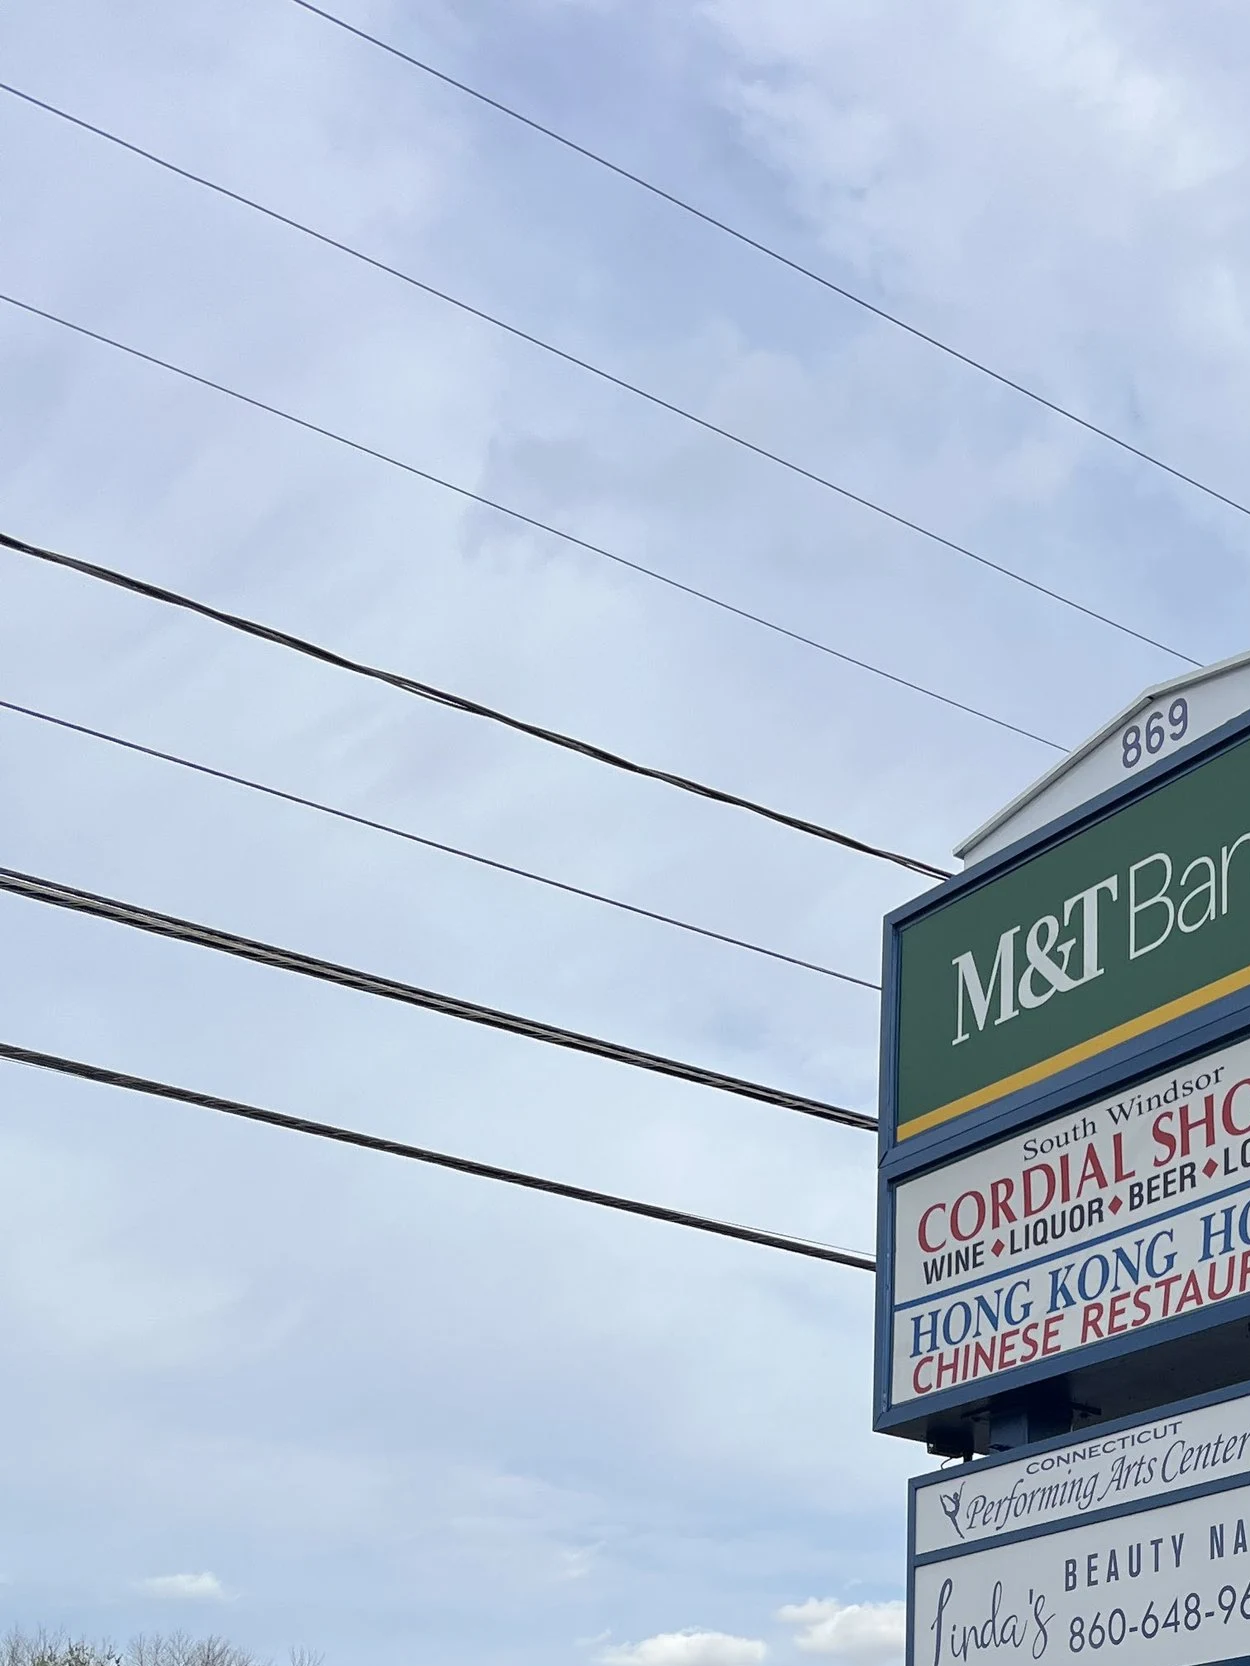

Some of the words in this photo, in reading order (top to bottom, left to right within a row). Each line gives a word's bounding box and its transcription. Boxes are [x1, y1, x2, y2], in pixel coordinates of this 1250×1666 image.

[1120, 698, 1189, 770] 869
[950, 874, 1118, 1047] M&T
[1023, 1119, 1097, 1161] South
[1108, 1065, 1226, 1122] Windsor
[917, 1132, 1136, 1254] CORDIAL
[923, 1239, 985, 1285] WINE
[1009, 1196, 1104, 1256] LIQUOR
[1128, 1161, 1197, 1212] BEER
[909, 1279, 1031, 1359] HONG
[1047, 1228, 1176, 1314] KONG
[912, 1314, 1065, 1395] CHINESE
[965, 1468, 1099, 1531] Performing
[1096, 1451, 1158, 1502] Arts
[1026, 1420, 1182, 1475] CONNECTICUT
[1064, 1533, 1185, 1592] BEAUTY
